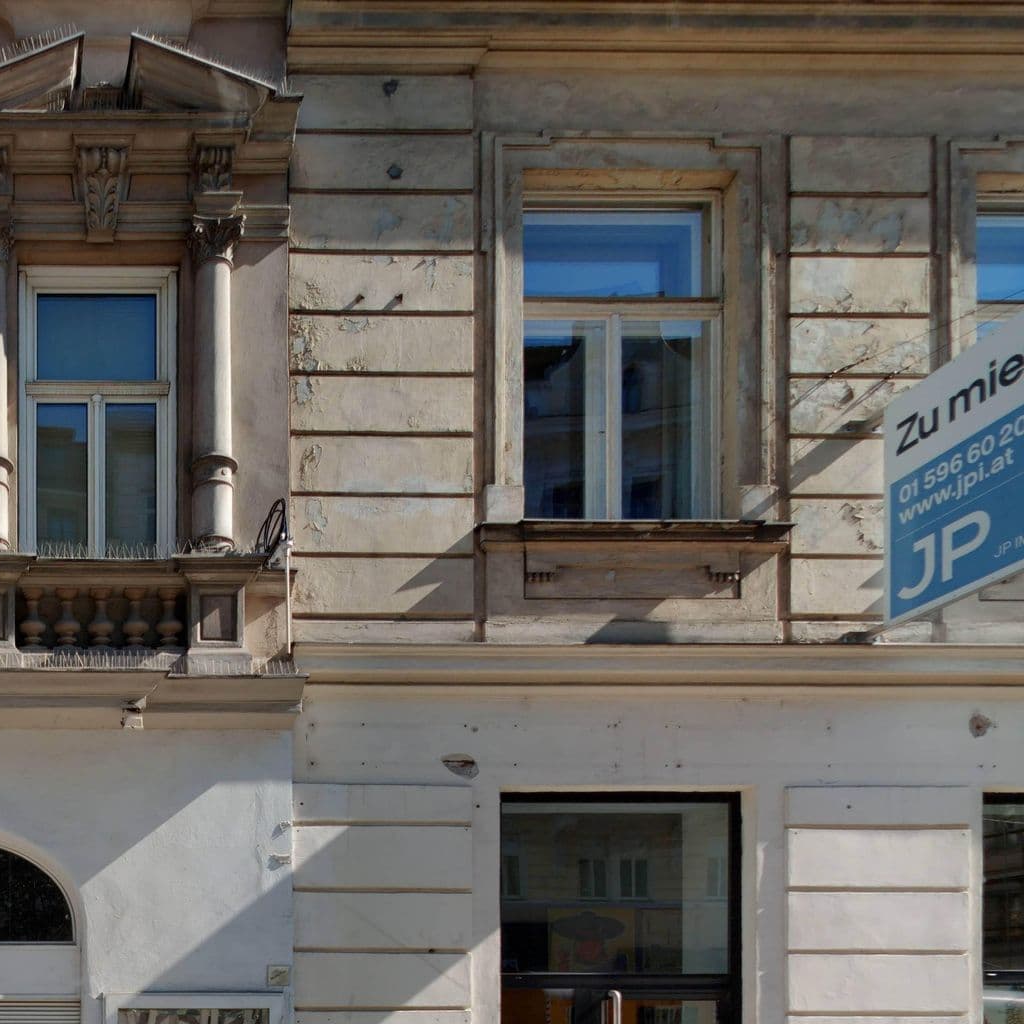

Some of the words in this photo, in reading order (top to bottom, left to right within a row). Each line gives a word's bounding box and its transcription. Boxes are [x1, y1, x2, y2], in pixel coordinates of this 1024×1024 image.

[896, 406, 939, 456] Zu
[948, 353, 1024, 423] mie
[898, 447, 1015, 525] www.jpi.at
[899, 478, 919, 503] 01
[923, 452, 963, 489] 596
[967, 434, 995, 464] 60
[999, 414, 1024, 447] 20
[897, 510, 991, 599] JP
[993, 540, 1012, 558] JP
